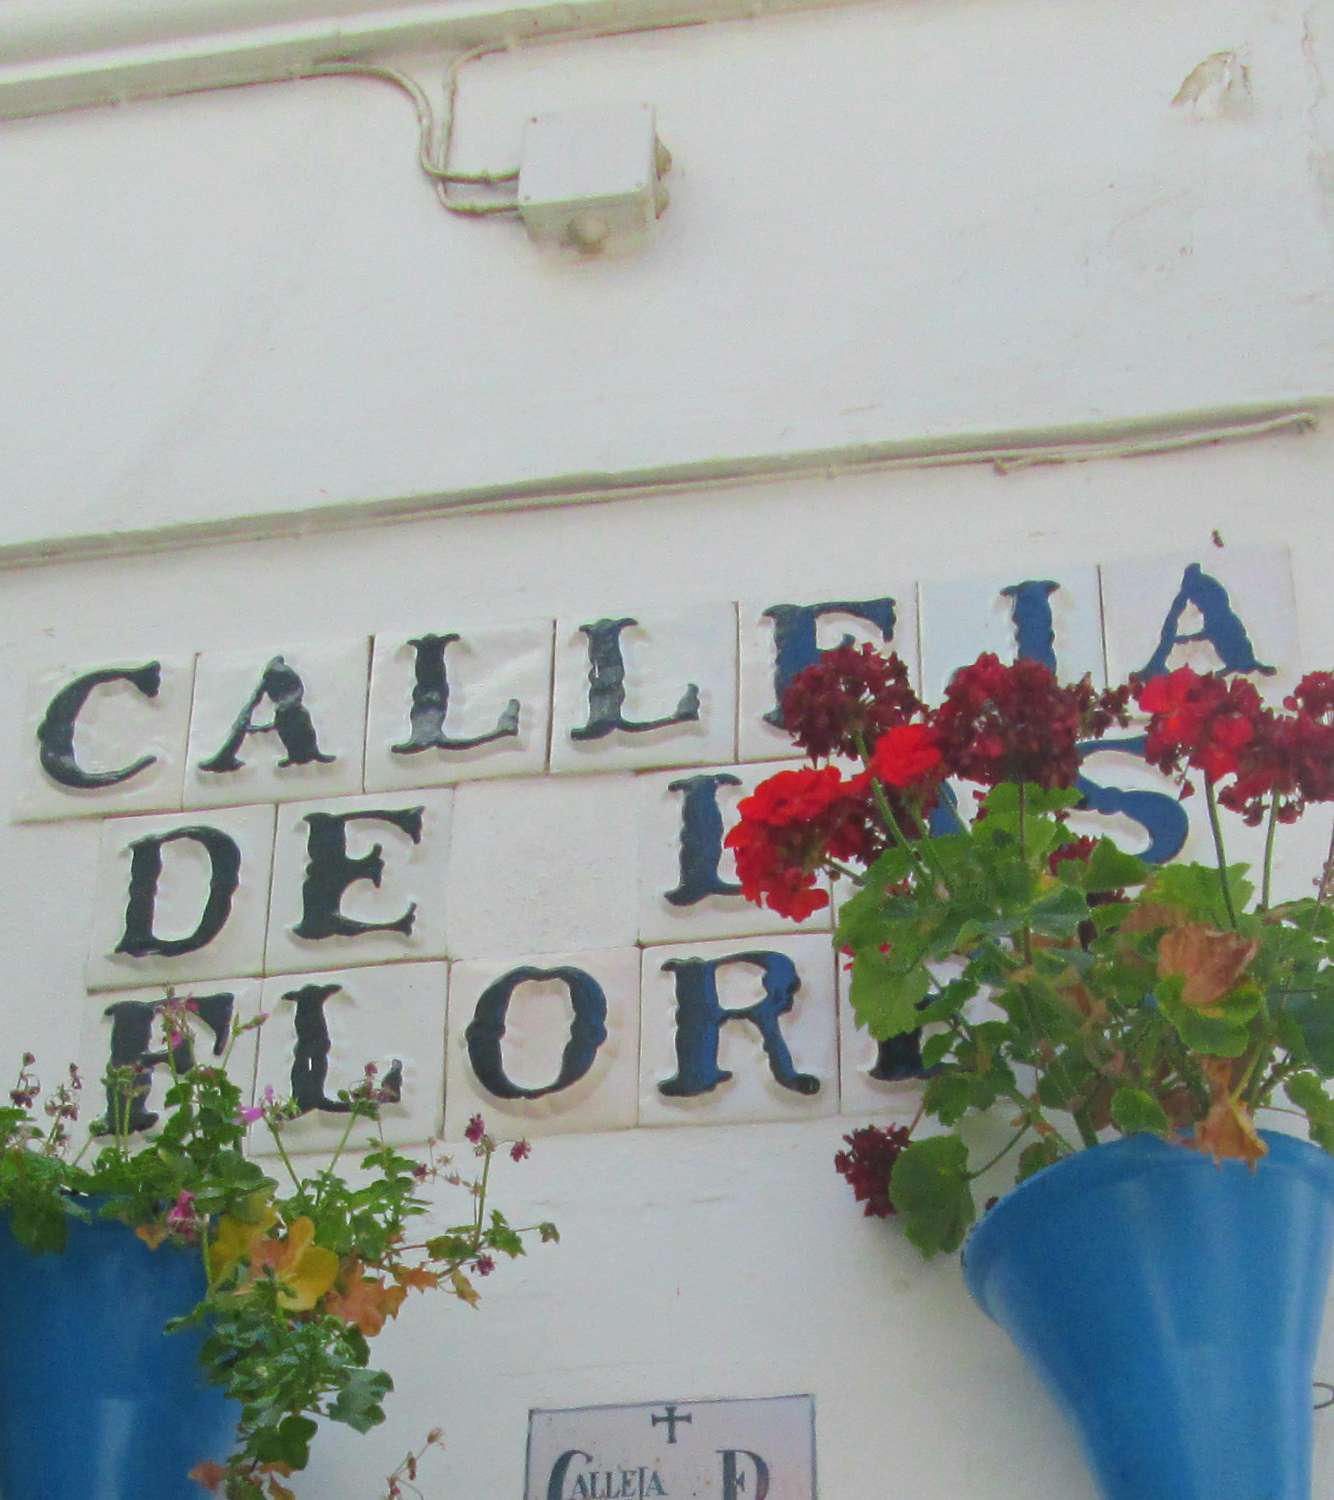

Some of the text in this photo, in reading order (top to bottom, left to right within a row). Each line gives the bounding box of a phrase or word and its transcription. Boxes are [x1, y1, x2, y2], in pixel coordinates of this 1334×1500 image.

[114, 735, 1189, 957] DE LS
[85, 948, 957, 1138] FLOR
